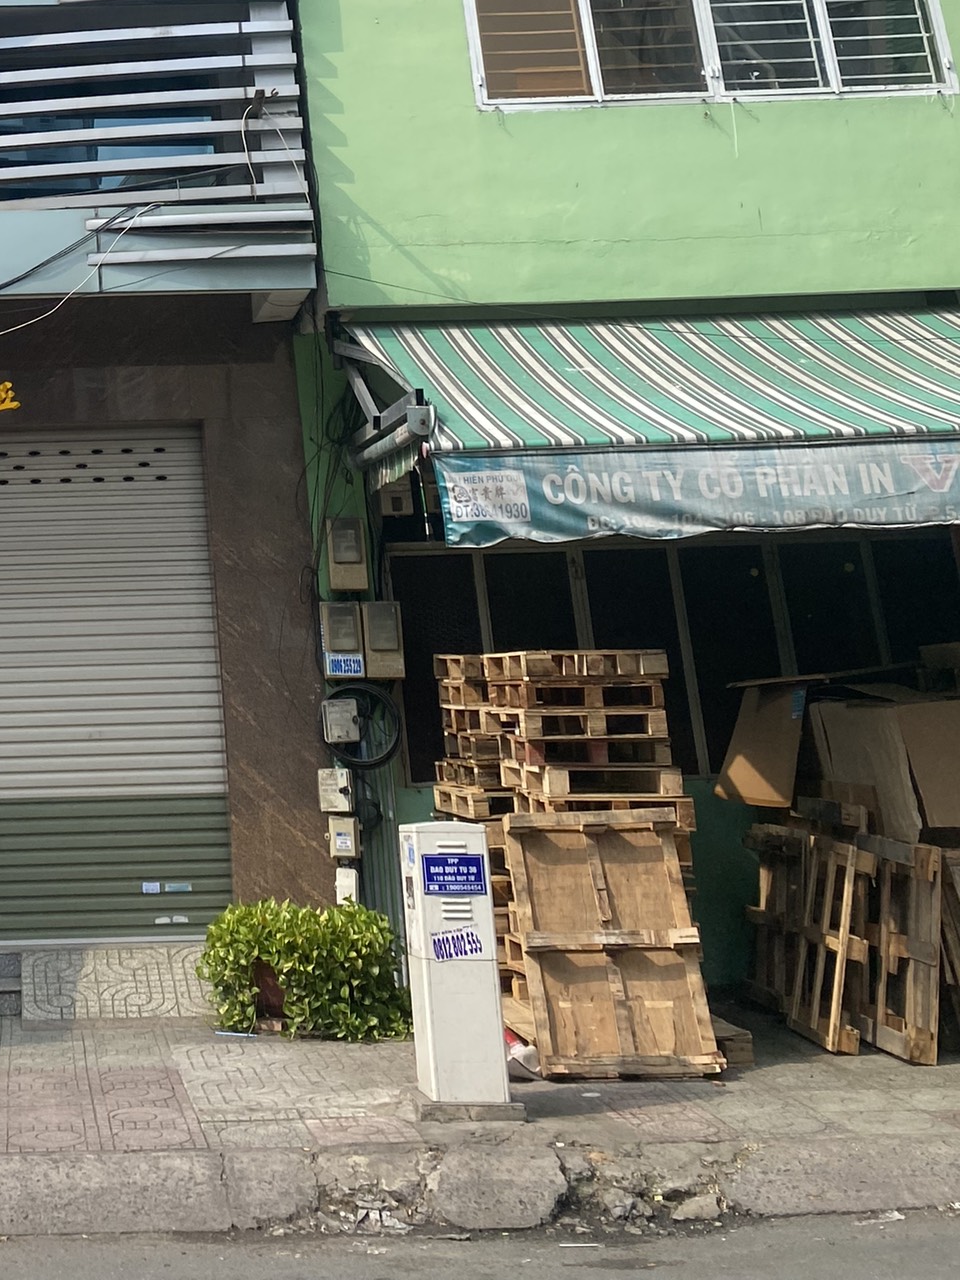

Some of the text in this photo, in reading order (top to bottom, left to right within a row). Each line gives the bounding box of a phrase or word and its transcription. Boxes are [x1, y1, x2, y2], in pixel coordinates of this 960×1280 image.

[542, 465, 635, 505] CÔNG
[642, 470, 684, 501] TY
[858, 462, 895, 495] IN
[773, 509, 807, 525] 108
[853, 506, 887, 523] DUY
